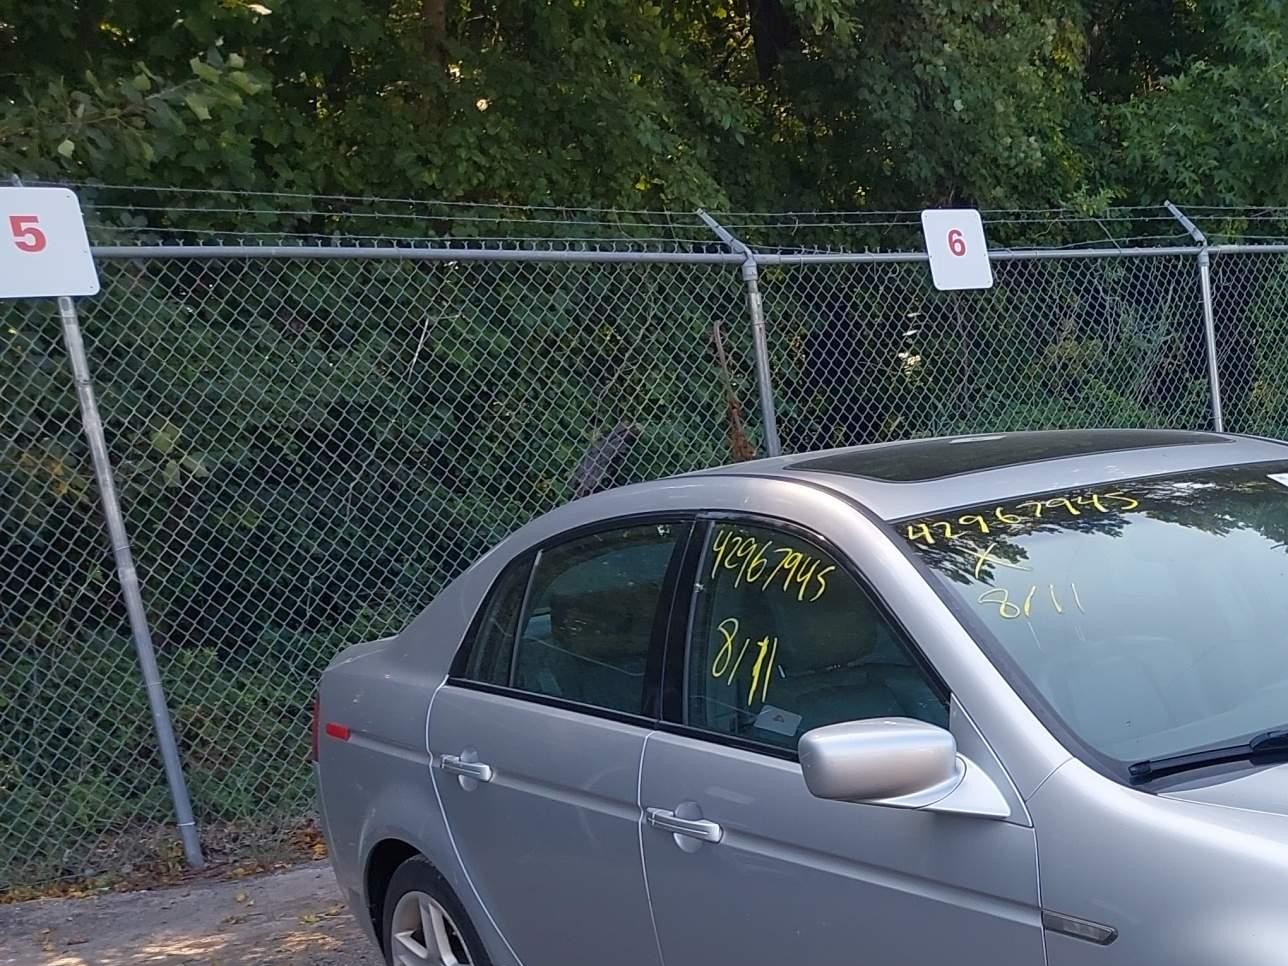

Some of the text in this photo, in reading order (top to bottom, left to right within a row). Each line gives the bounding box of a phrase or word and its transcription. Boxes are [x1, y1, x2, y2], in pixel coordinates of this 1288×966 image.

[9, 215, 47, 253] 5
[947, 228, 967, 257] 6
[907, 491, 1139, 545] 42967945
[711, 529, 836, 602] 42967945
[711, 617, 778, 706] 8/11
